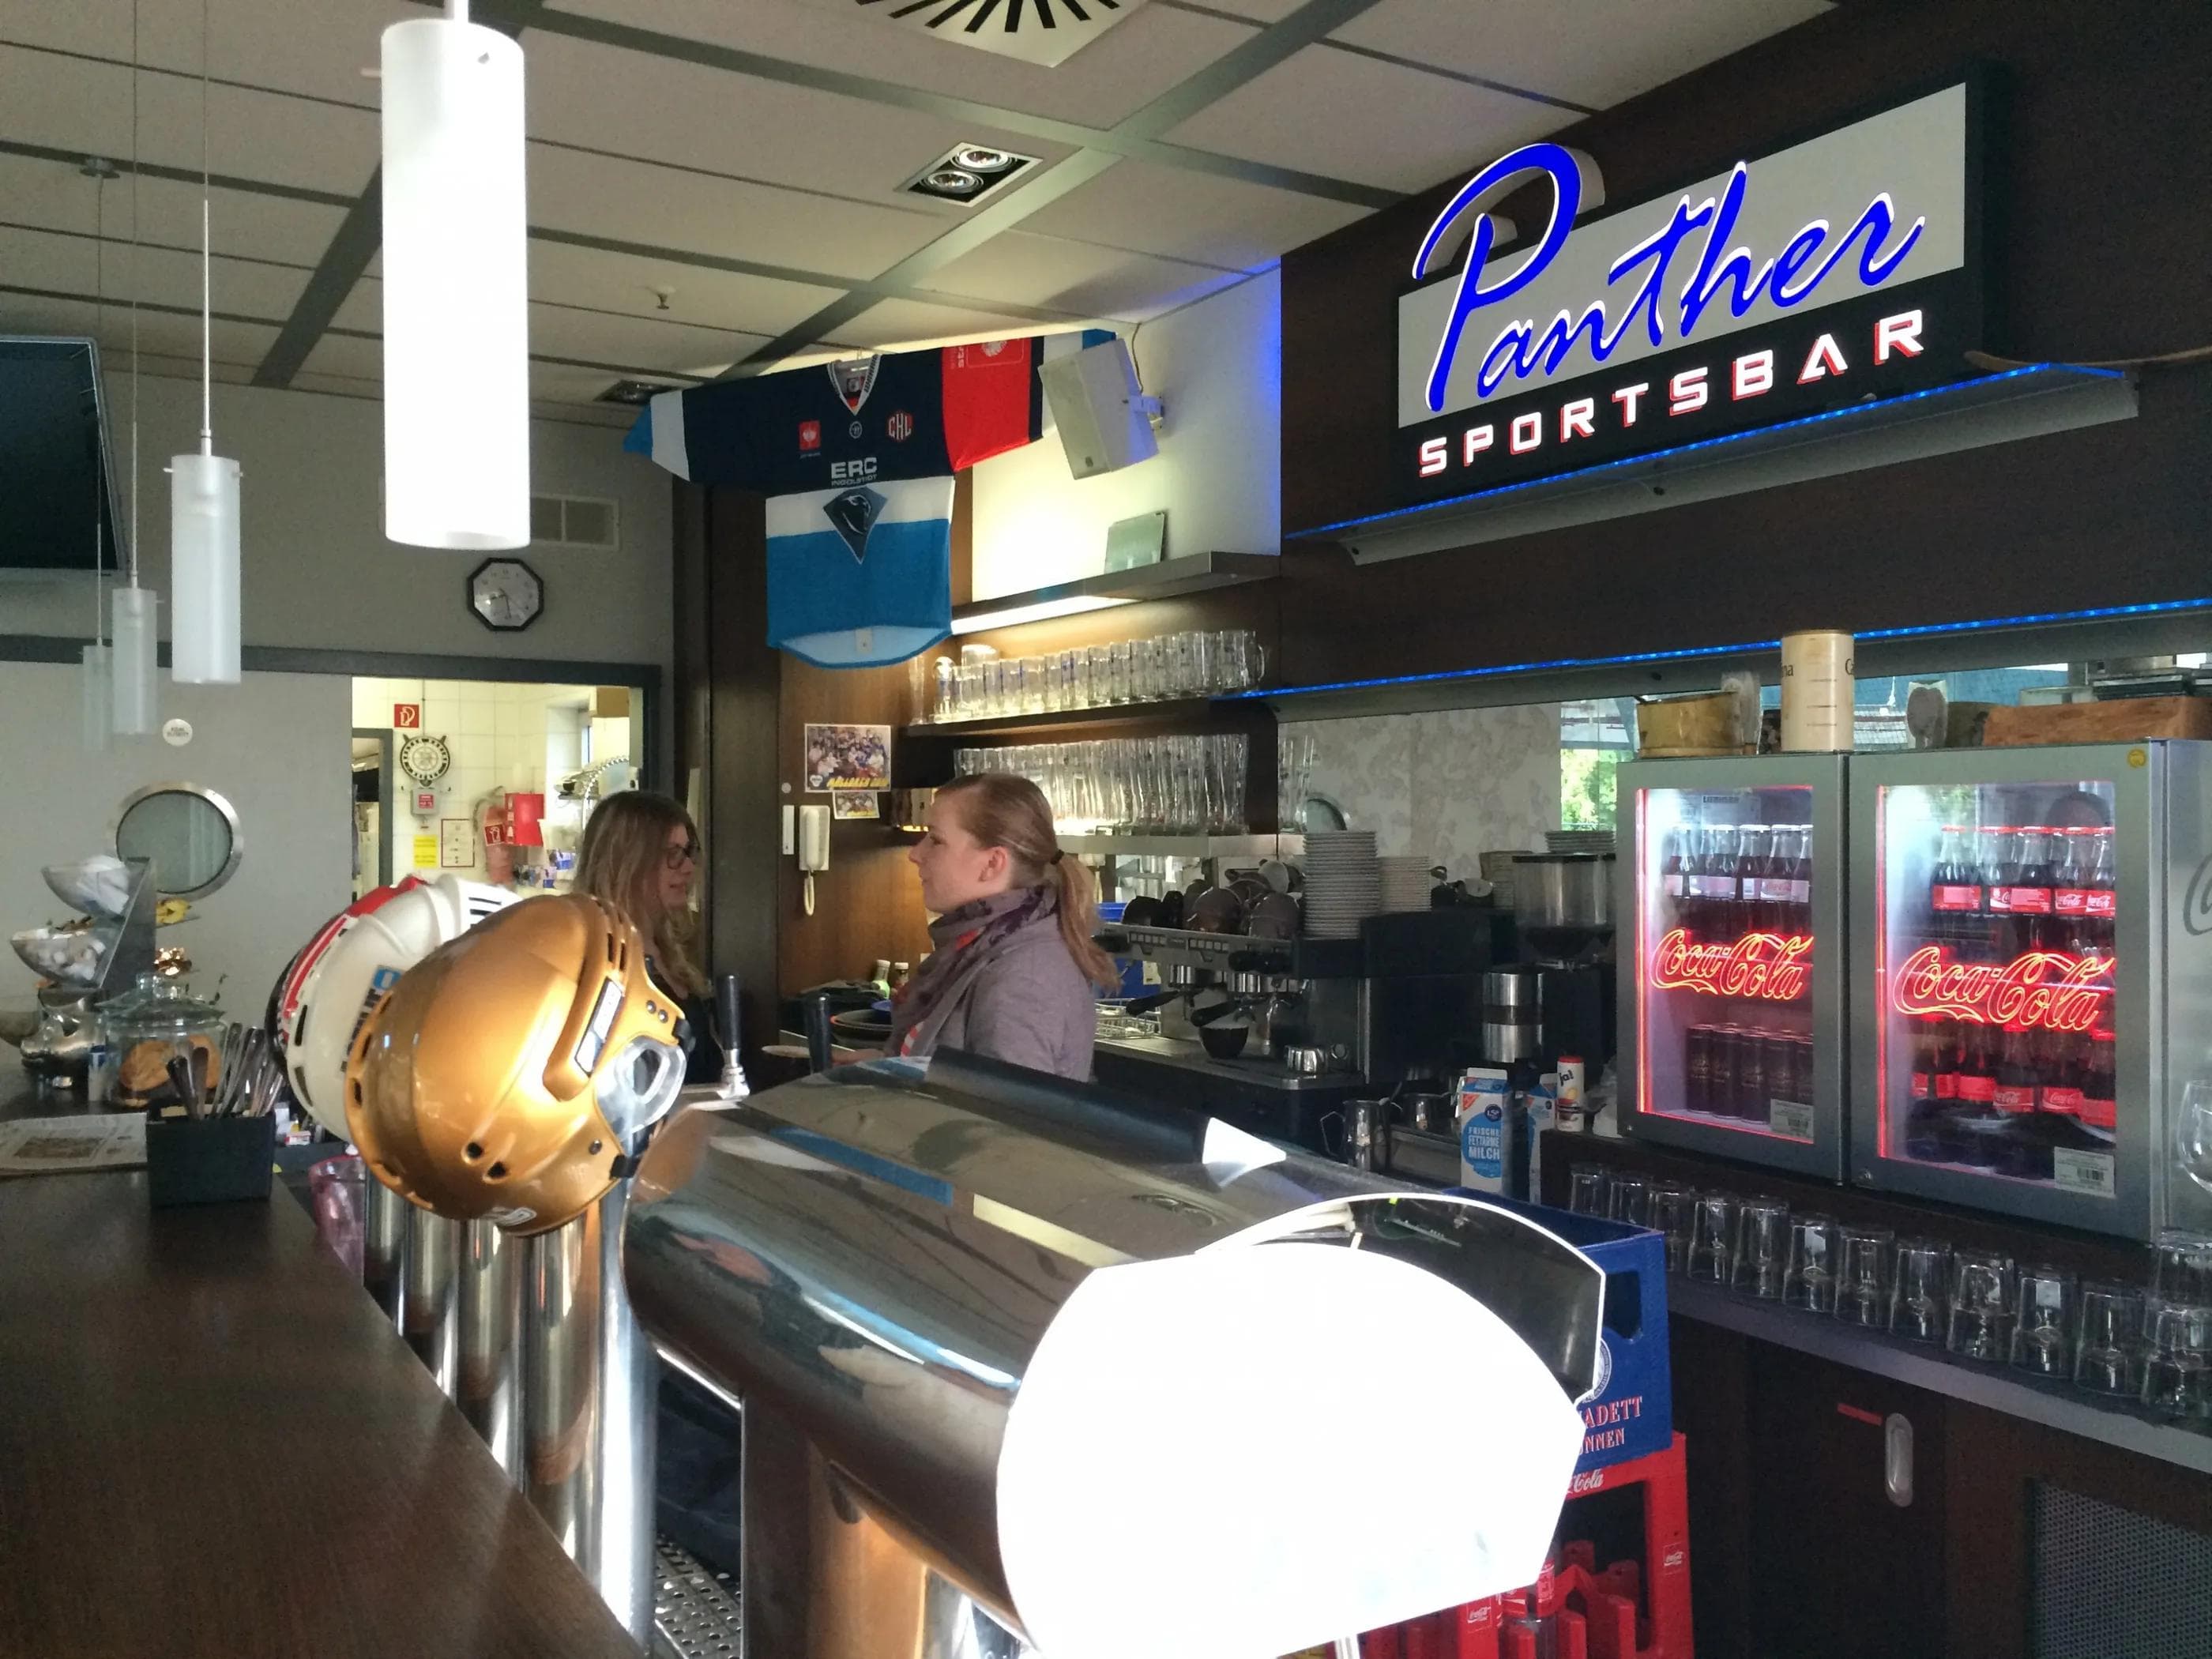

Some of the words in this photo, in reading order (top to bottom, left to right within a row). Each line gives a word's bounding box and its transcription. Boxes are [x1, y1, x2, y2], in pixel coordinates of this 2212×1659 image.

[1412, 142, 1925, 411] Panther
[1419, 309, 1925, 477] SPORTSBAR
[888, 412, 912, 440] CHL
[831, 457, 878, 480] ERC
[1650, 928, 1815, 1000] Coca-Cola
[1893, 946, 2116, 1031] Coca-Cola
[1469, 1146, 1500, 1160] MILCH
[1579, 1396, 1643, 1429] ADETT
[1567, 1468, 1604, 1494] Cola
